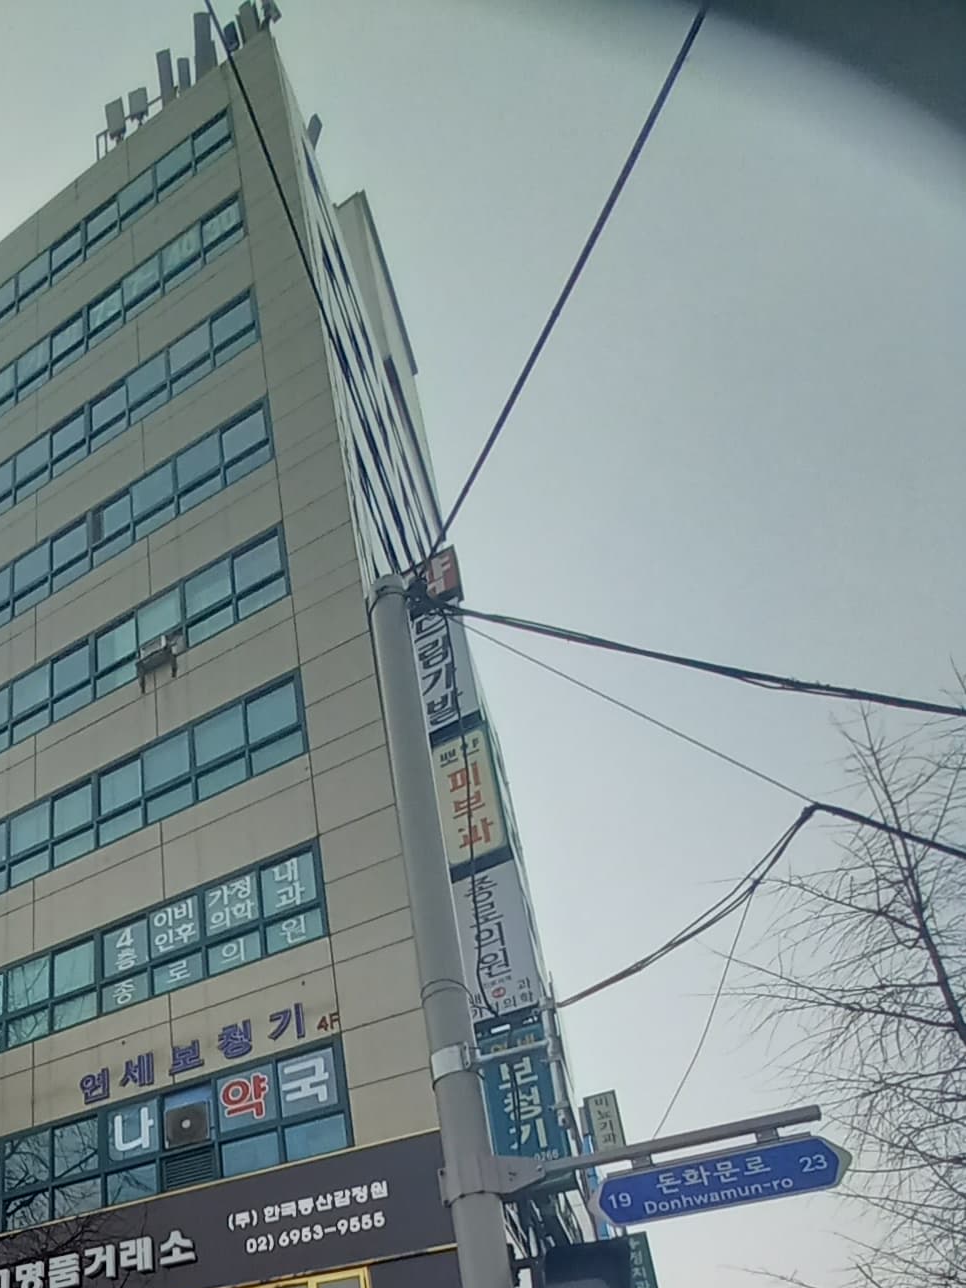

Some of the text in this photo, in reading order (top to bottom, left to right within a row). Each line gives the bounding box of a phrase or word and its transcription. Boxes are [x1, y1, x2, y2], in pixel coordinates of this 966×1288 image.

[447, 761, 494, 848] 피부과
[80, 1003, 339, 1105] 연세보청기 4F
[220, 1057, 330, 1119] 약국
[498, 1056, 548, 1151] 보청기
[607, 1154, 829, 1209] 19 돈화문로 23
[643, 1176, 794, 1216] Donhwamun-ro
[228, 1211, 258, 1231] (주)
[246, 1211, 385, 1254] 02) 6953-9555
